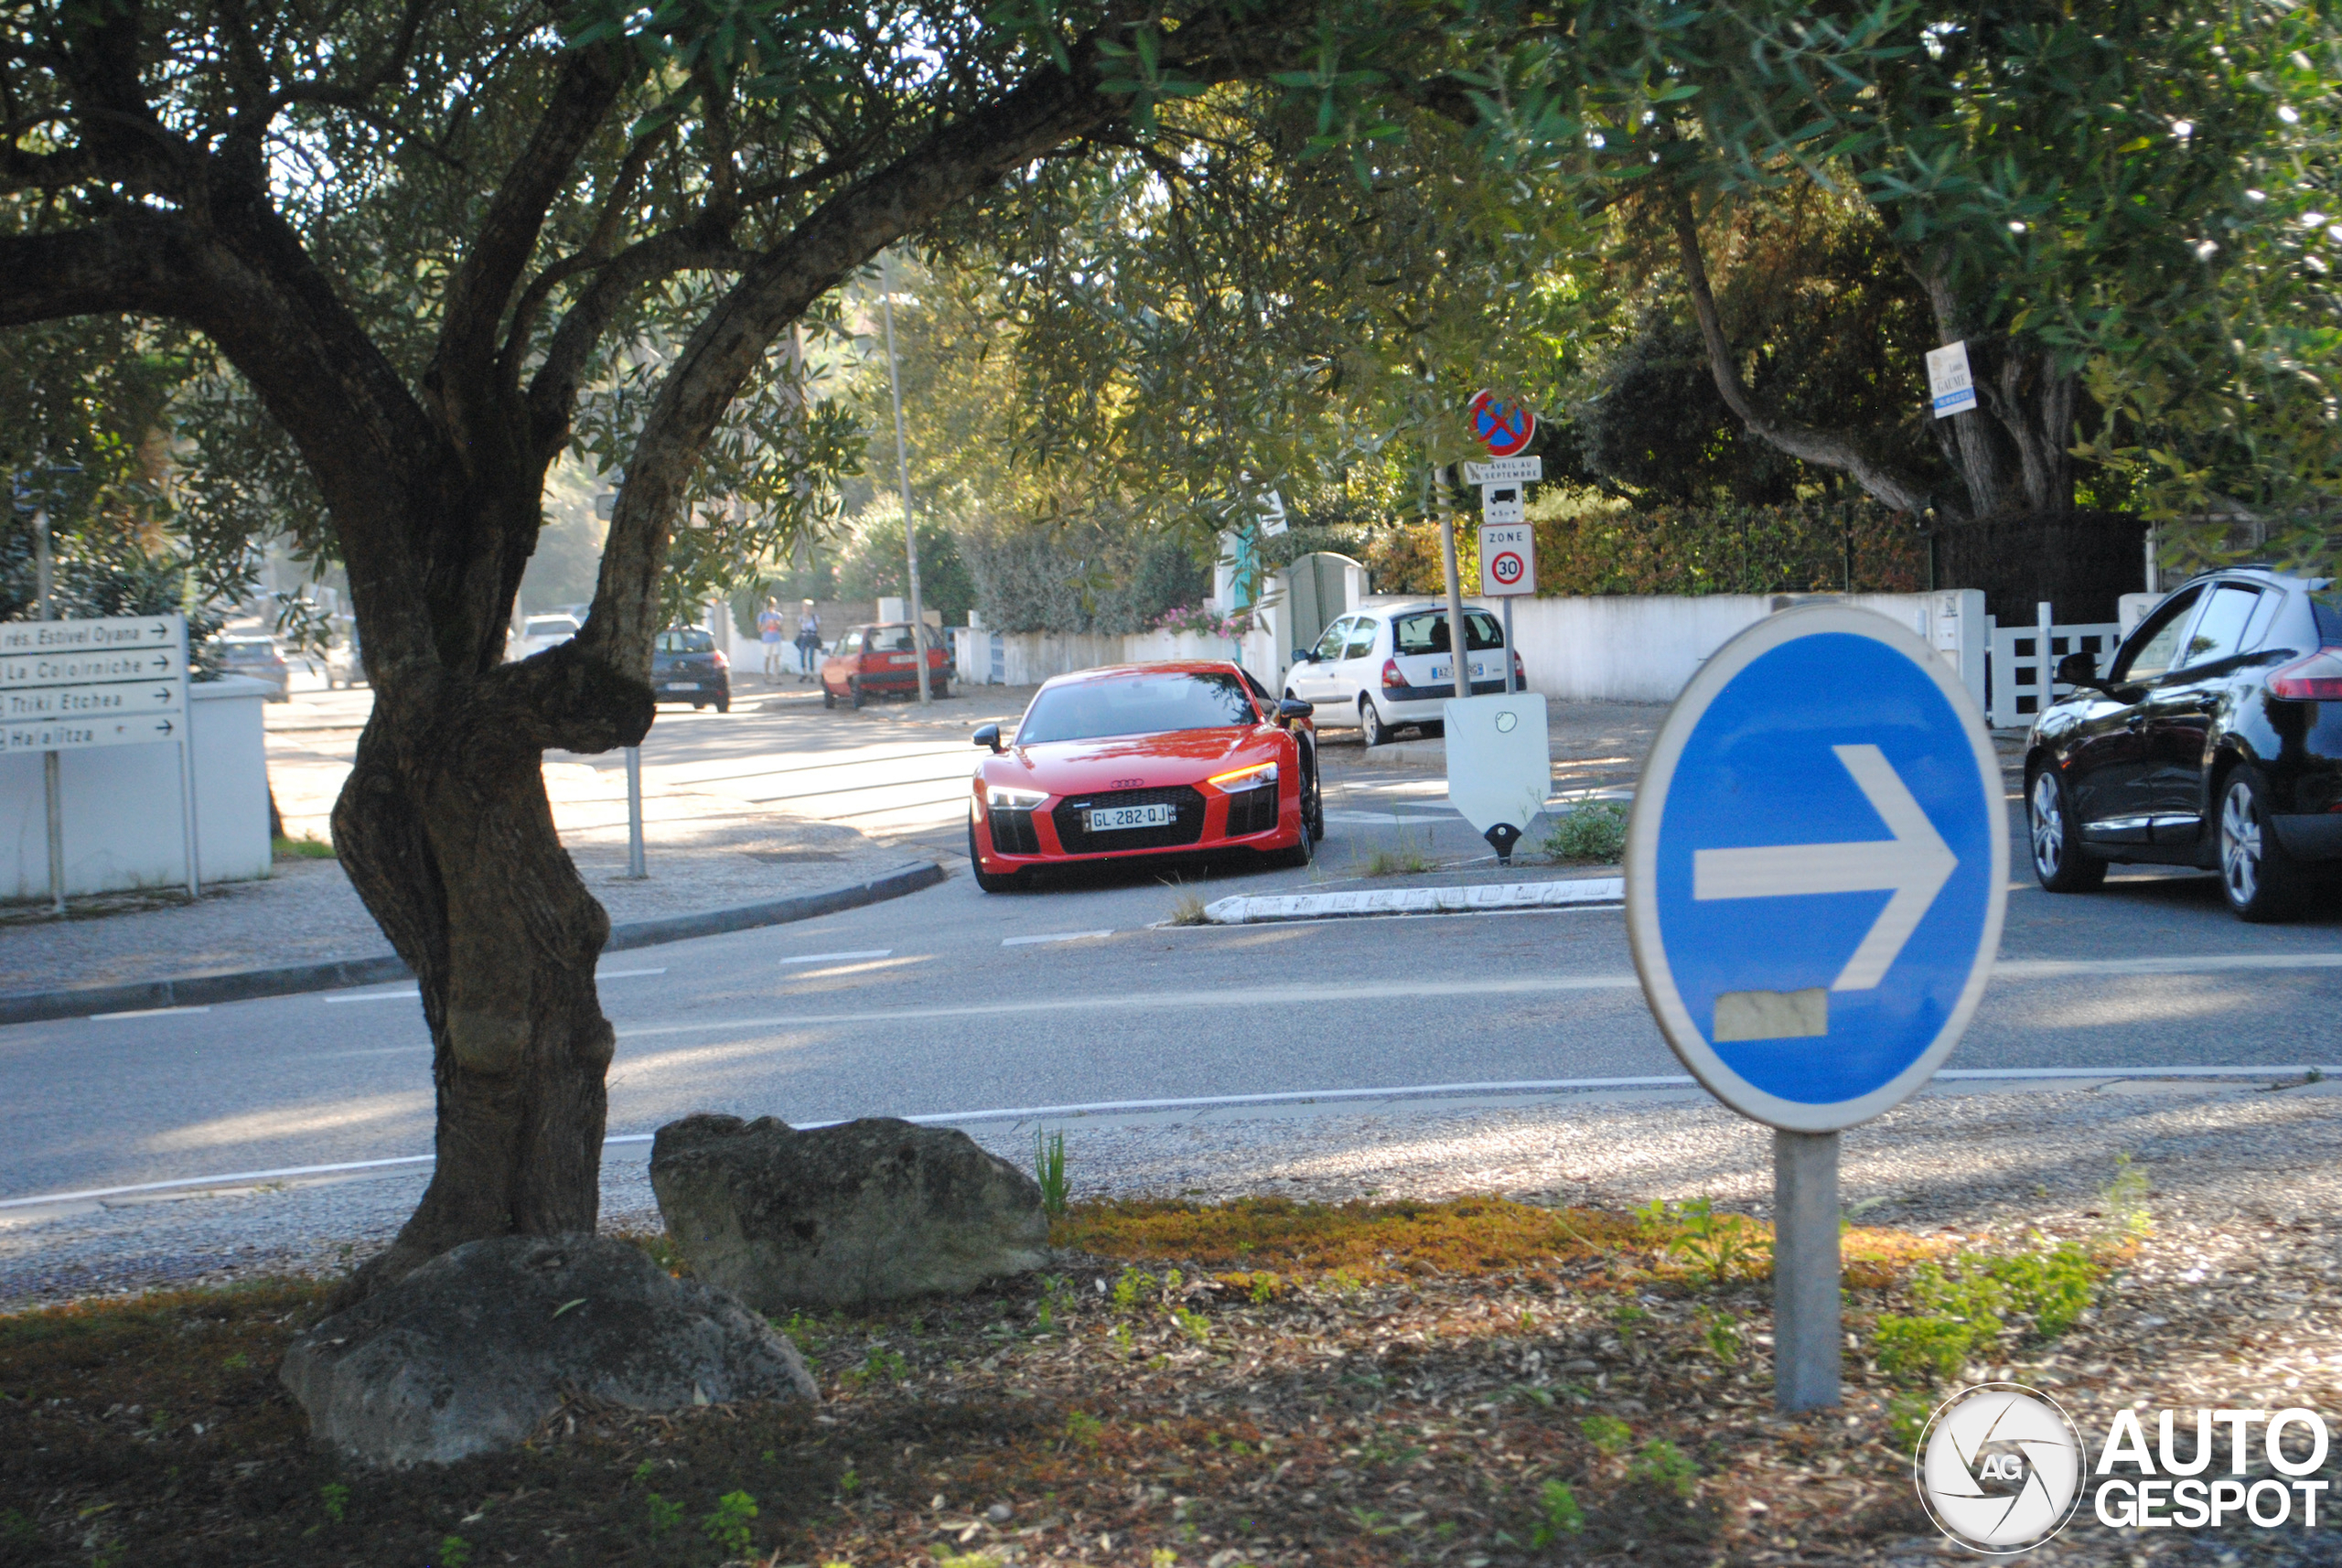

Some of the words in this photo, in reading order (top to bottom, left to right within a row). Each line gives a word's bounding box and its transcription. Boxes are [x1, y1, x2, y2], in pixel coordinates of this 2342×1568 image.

[1937, 374, 1966, 392] GAUME
[1491, 460, 1516, 469] AVRIL
[1520, 460, 1532, 468] AU
[1485, 469, 1537, 479] SEPTEMBRE
[1489, 532, 1523, 543] ZONE
[1499, 561, 1518, 575] 30
[8, 664, 27, 680] La
[60, 693, 122, 711] Etchea
[1093, 807, 1166, 827] GL-282-QJ
